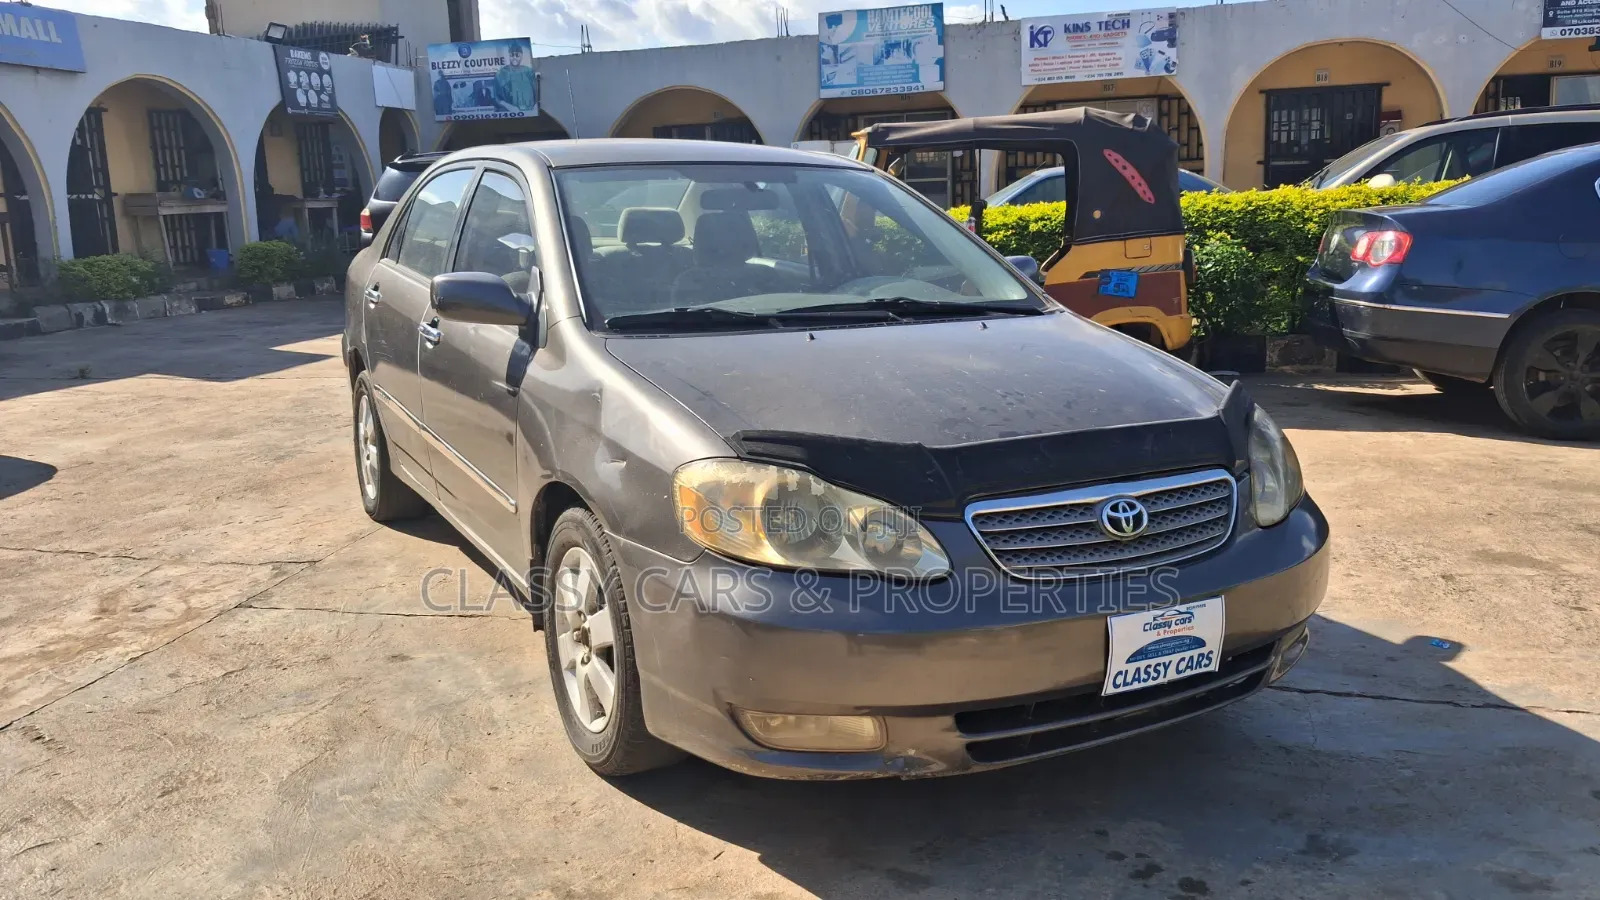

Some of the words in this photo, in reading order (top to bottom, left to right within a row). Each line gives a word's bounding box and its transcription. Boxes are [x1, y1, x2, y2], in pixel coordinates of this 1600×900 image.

[0, 12, 62, 44] MALL
[868, 19, 935, 32] VENTURES
[1064, 21, 1092, 34] KINS
[1096, 19, 1130, 31] TECH
[431, 61, 462, 71] BLEZZY
[464, 57, 506, 68] COUTURE
[1316, 73, 1328, 82] B18
[851, 85, 925, 96] 08067233941
[454, 111, 525, 121] 09051691400
[1143, 620, 1173, 632] Classy
[1174, 615, 1192, 626] cars
[1163, 625, 1195, 636] Properties
[1112, 660, 1173, 689] CLASSY
[1175, 650, 1214, 675] CARS
